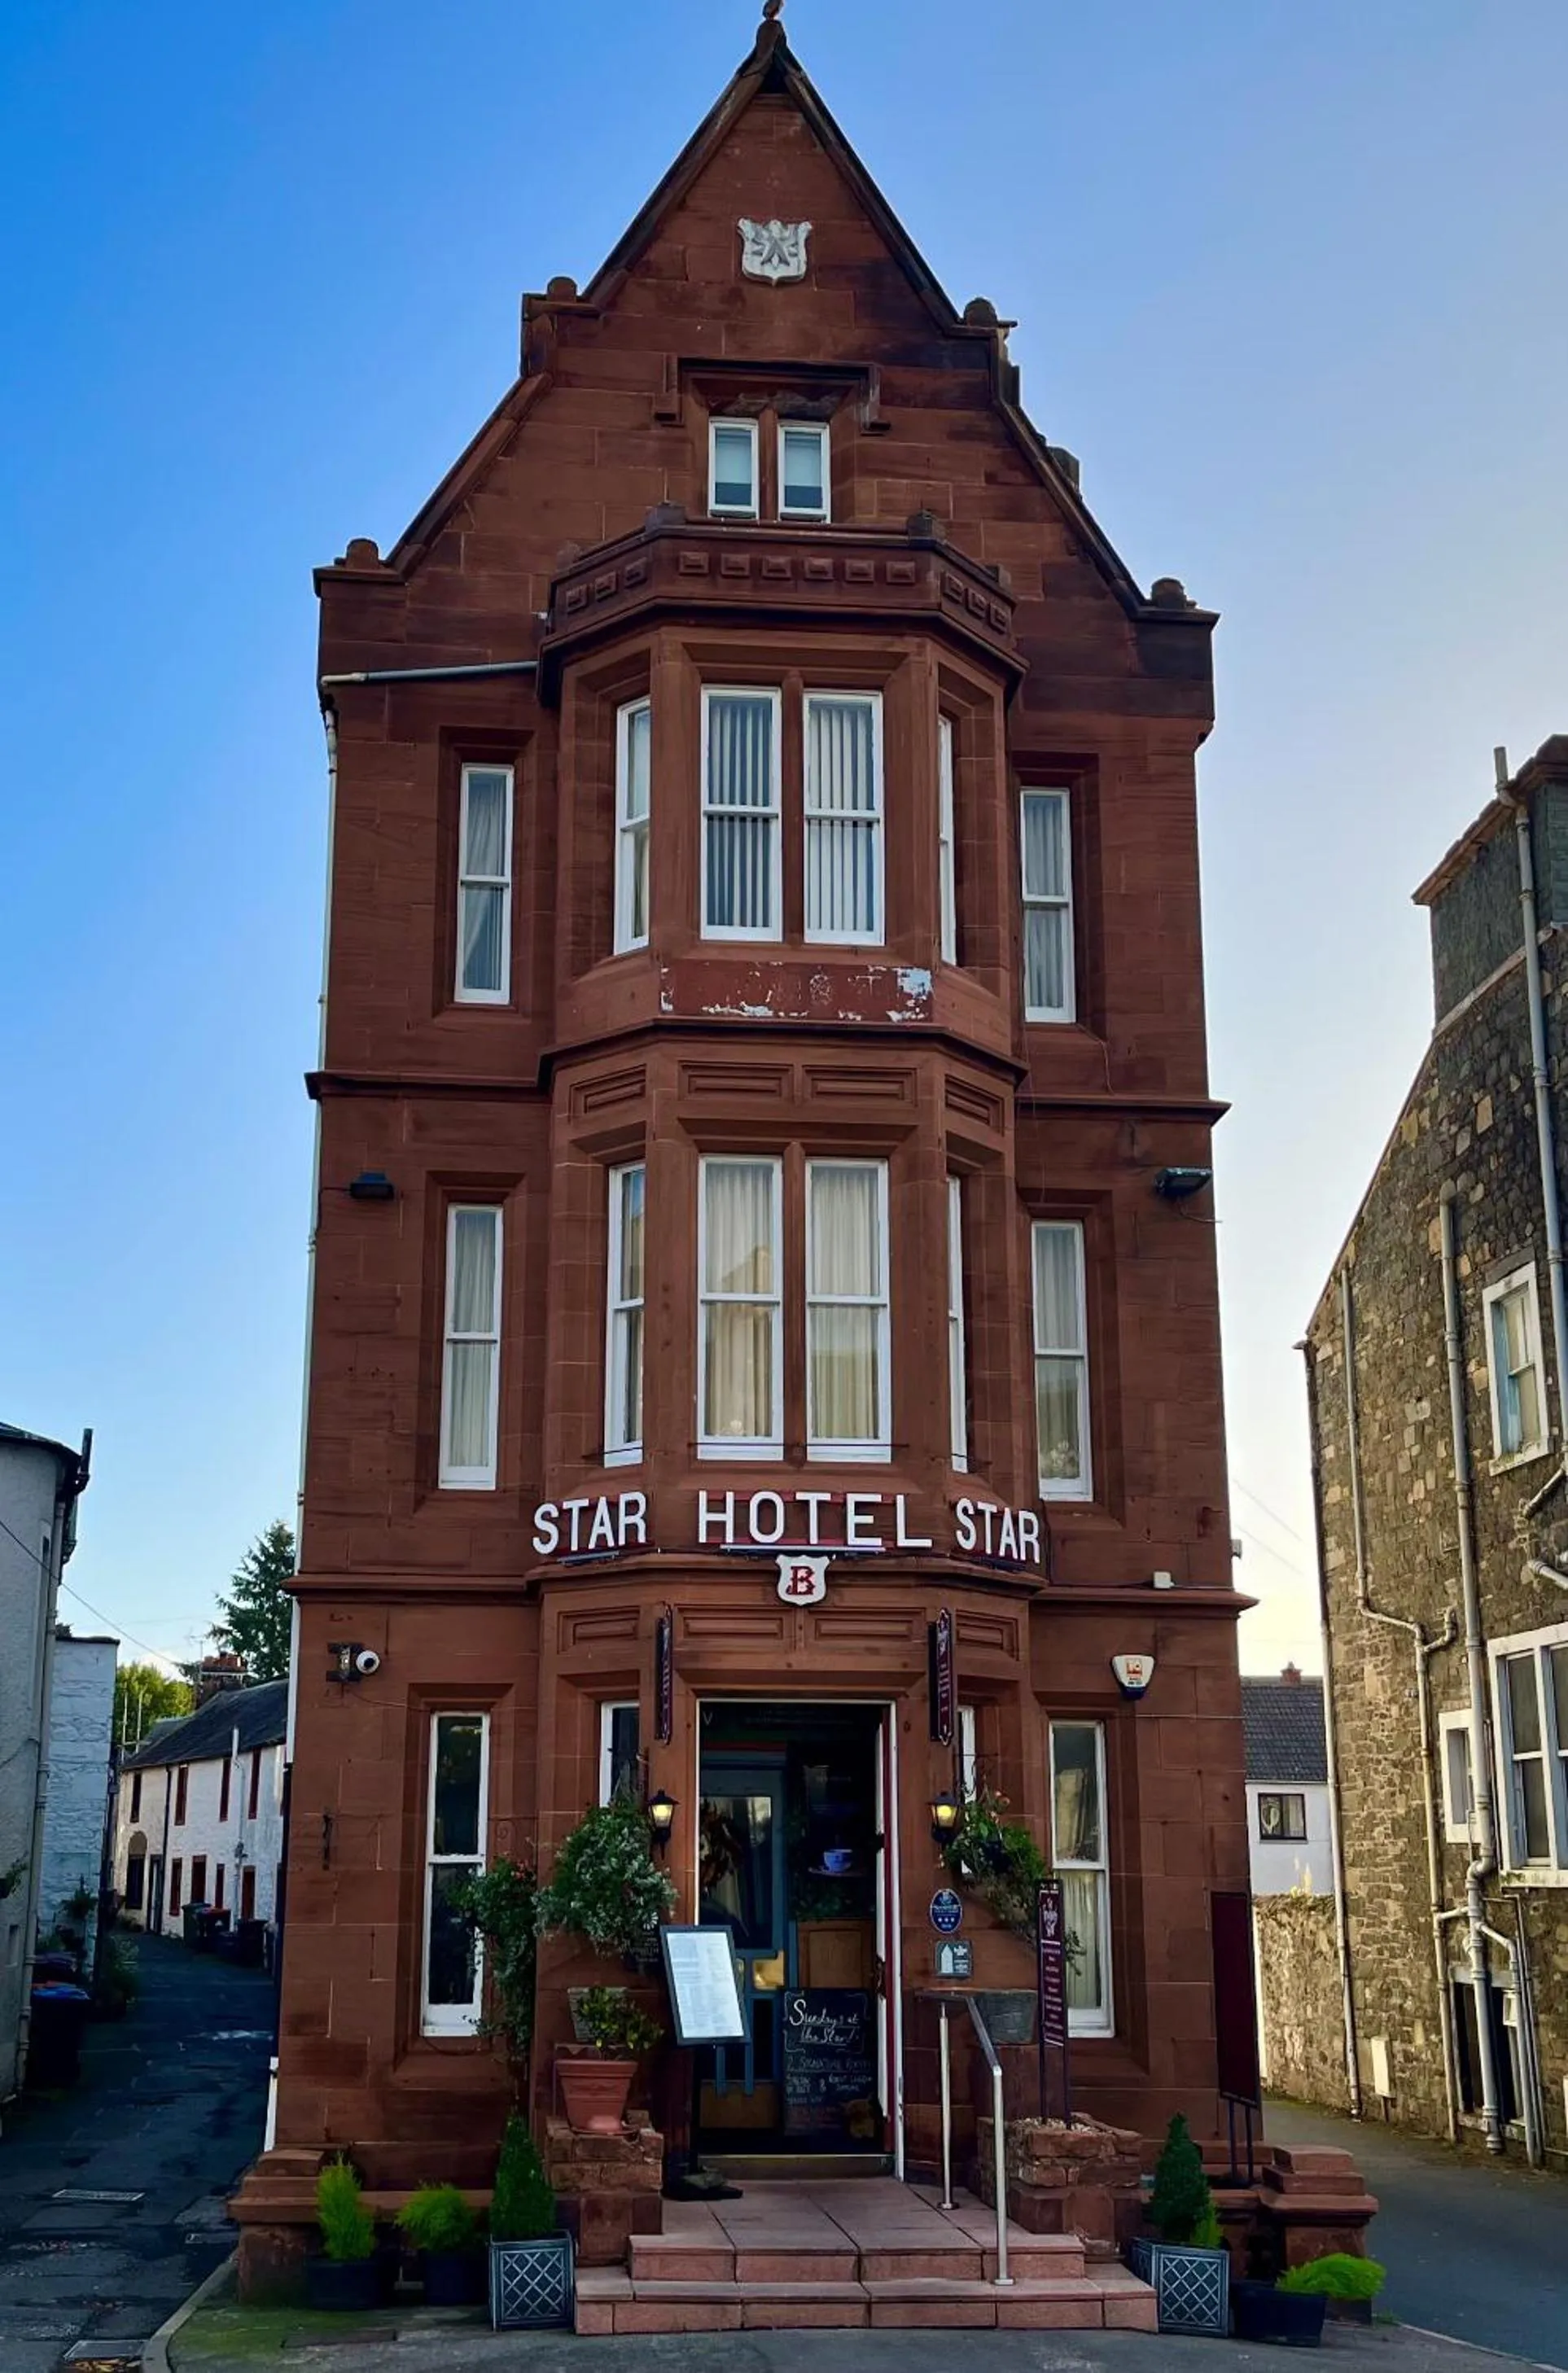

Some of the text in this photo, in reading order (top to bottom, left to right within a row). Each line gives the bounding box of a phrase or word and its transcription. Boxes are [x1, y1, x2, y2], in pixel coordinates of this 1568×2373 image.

[532, 1491, 1040, 1563] STAR HOTEL STAR
[786, 1565, 816, 1596] B
